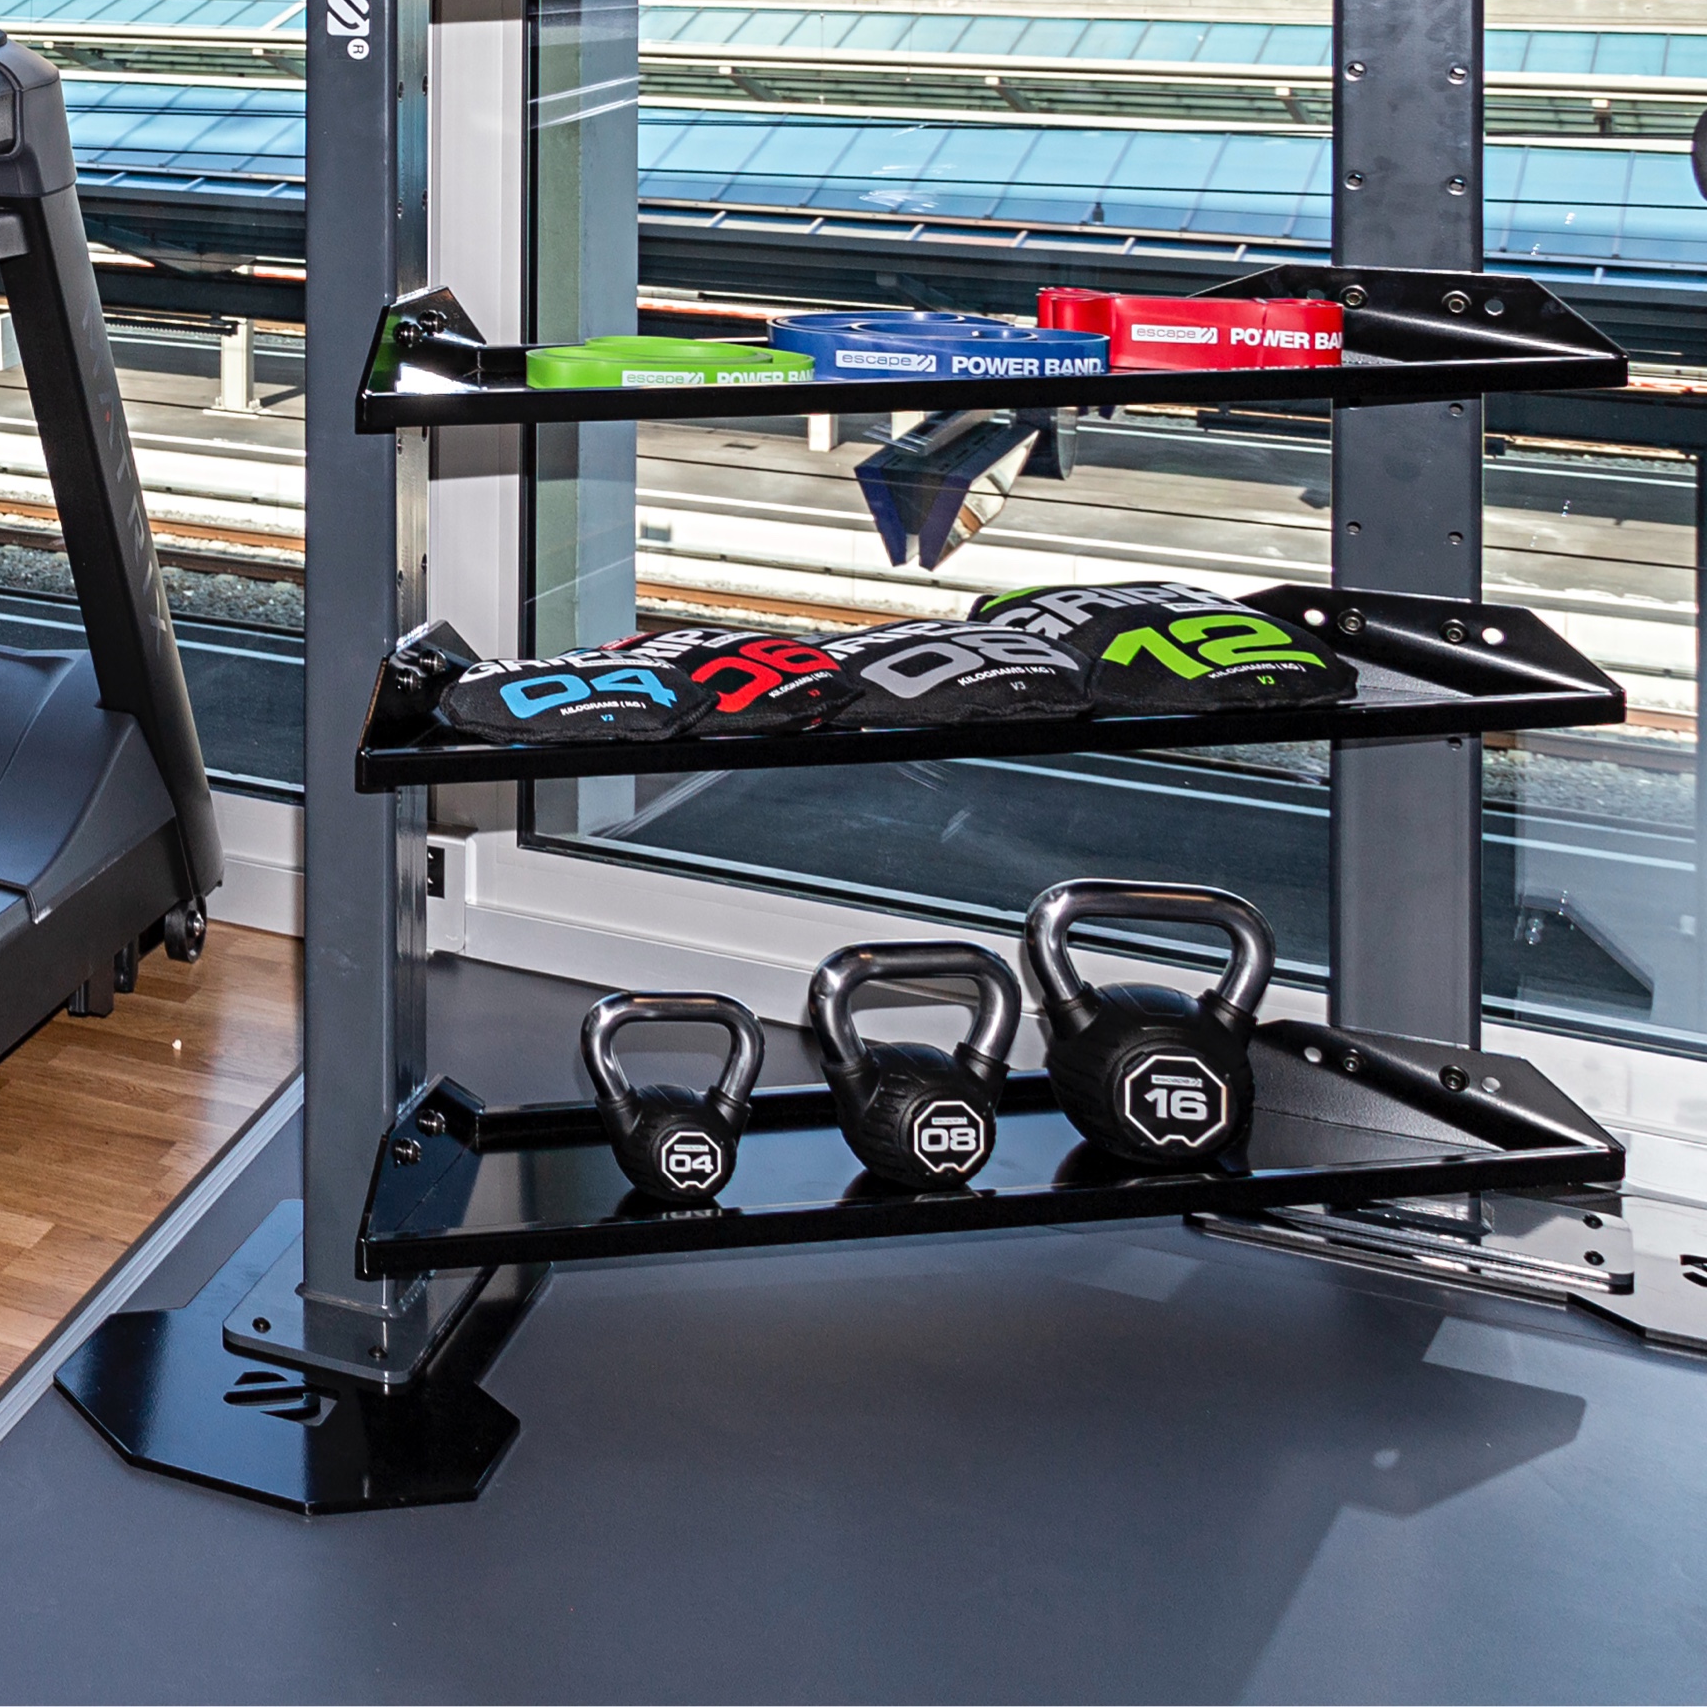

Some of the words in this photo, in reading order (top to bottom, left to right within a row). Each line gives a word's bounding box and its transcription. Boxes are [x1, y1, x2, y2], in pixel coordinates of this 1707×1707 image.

[1136, 327, 1197, 339] escape
[1315, 333, 1342, 350] BA
[841, 353, 912, 367] escape
[951, 356, 1039, 375] POWER
[627, 373, 684, 384] escape
[1101, 614, 1326, 680] 12
[860, 633, 1080, 699] 08
[690, 639, 842, 713] 06
[957, 666, 1026, 687] KILOGRAMS
[1010, 680, 1026, 691] V3
[1256, 675, 1275, 685] V3
[499, 668, 678, 719] 04
[559, 700, 619, 716] KILOGRAMS
[1143, 1088, 1208, 1121] 16
[921, 1127, 976, 1152] 08
[669, 1154, 714, 1173] 04
